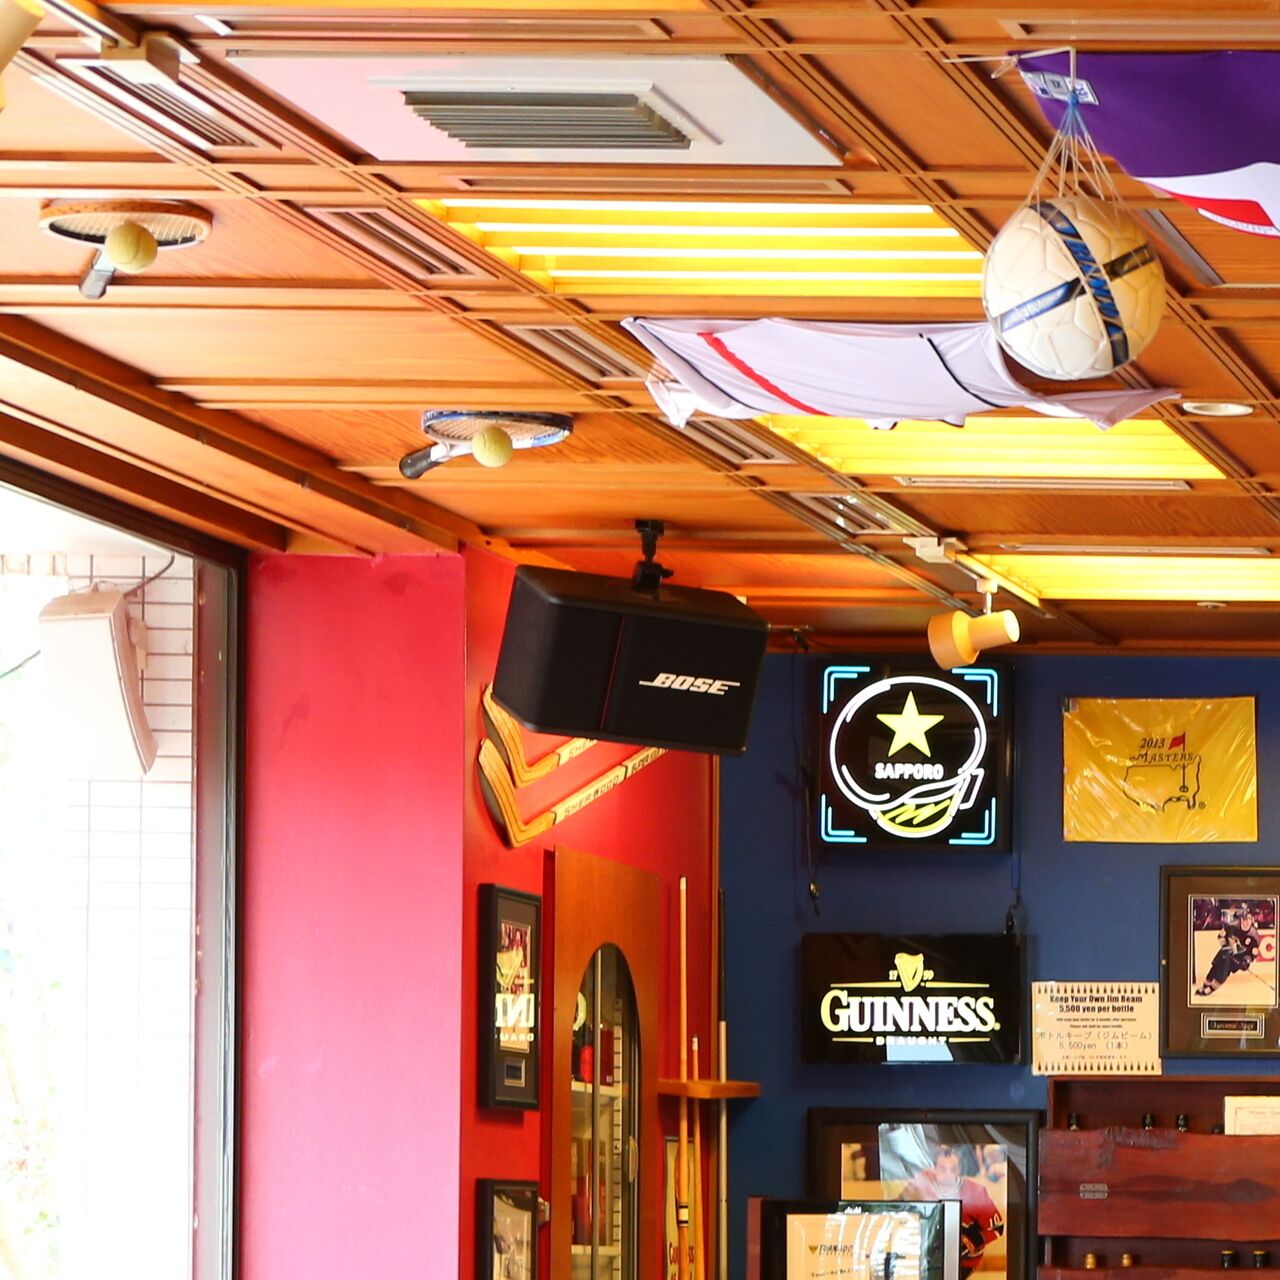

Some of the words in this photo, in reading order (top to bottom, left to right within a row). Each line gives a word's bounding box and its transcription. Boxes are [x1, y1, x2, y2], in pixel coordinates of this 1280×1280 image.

[644, 673, 737, 695] BOSE
[1139, 738, 1166, 749] 2013
[875, 763, 944, 780] SAPPORO
[1050, 995, 1069, 1003] Keep
[1071, 995, 1087, 1003] Your
[1089, 995, 1105, 1003] Own
[1107, 995, 1119, 1003] Jim
[1121, 995, 1143, 1003] Beam
[821, 990, 997, 1032] GUINNESS
[1059, 1005, 1081, 1013] 5,500
[1112, 1005, 1134, 1013] bottle
